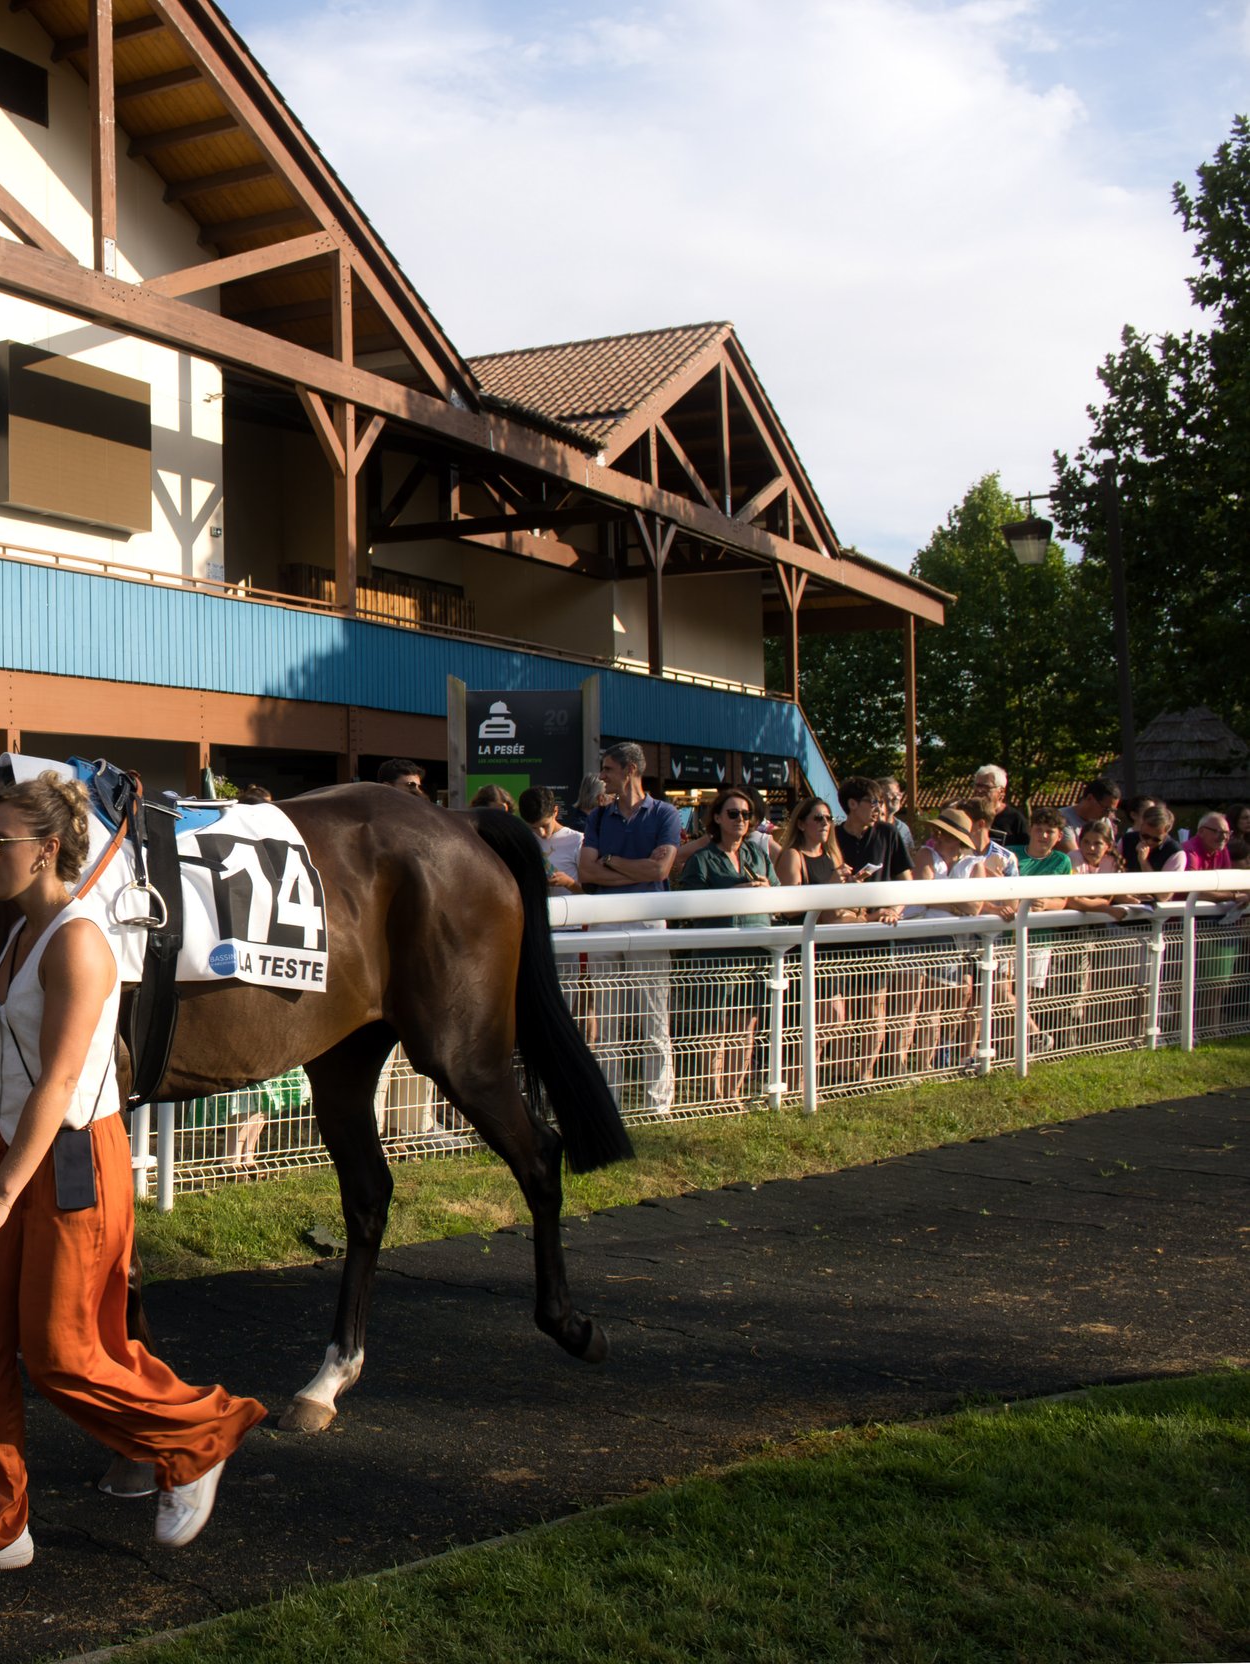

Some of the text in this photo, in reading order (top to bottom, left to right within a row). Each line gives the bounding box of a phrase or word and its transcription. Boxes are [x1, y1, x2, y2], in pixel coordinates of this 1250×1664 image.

[543, 709, 568, 726] 20
[478, 743, 525, 755] LA PESÉE
[219, 842, 324, 949] 14
[239, 950, 323, 982] LA TESTE
